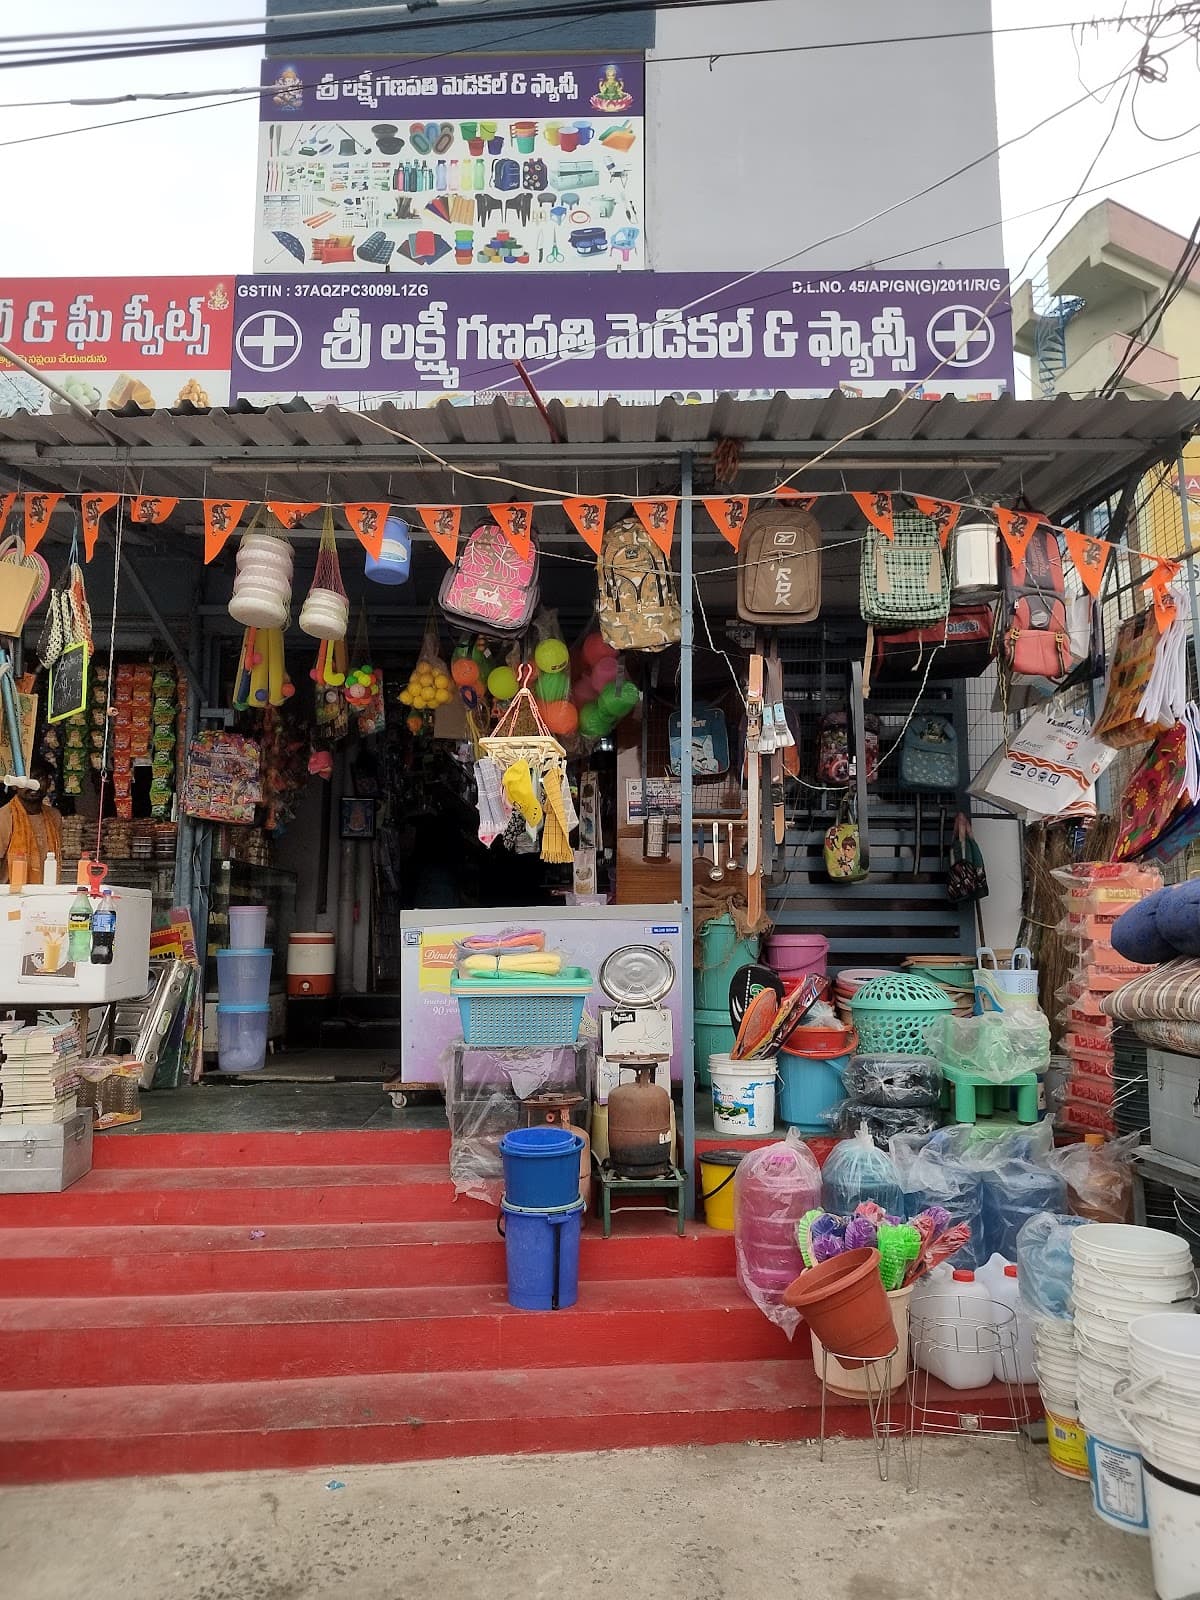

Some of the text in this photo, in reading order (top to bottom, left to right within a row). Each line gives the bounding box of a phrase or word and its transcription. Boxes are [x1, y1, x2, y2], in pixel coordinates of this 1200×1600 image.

[316, 74, 340, 100] శ్రీ
[377, 76, 438, 97] గణపతి
[511, 73, 527, 96] &
[237, 285, 282, 298] GSTIN
[294, 284, 429, 298] 37AQZPC3009L1ZG
[792, 279, 1001, 294] D.L.NO. 45/AP/GN(G)/2011/R/G
[23, 301, 57, 343] &
[67, 294, 113, 350] ఘీ
[121, 294, 210, 356] స్వీట్స్
[321, 301, 916, 388] శ్రీ లక్ష్మీ గణపతి మెడికల్ & ఫ్యాన్సీ
